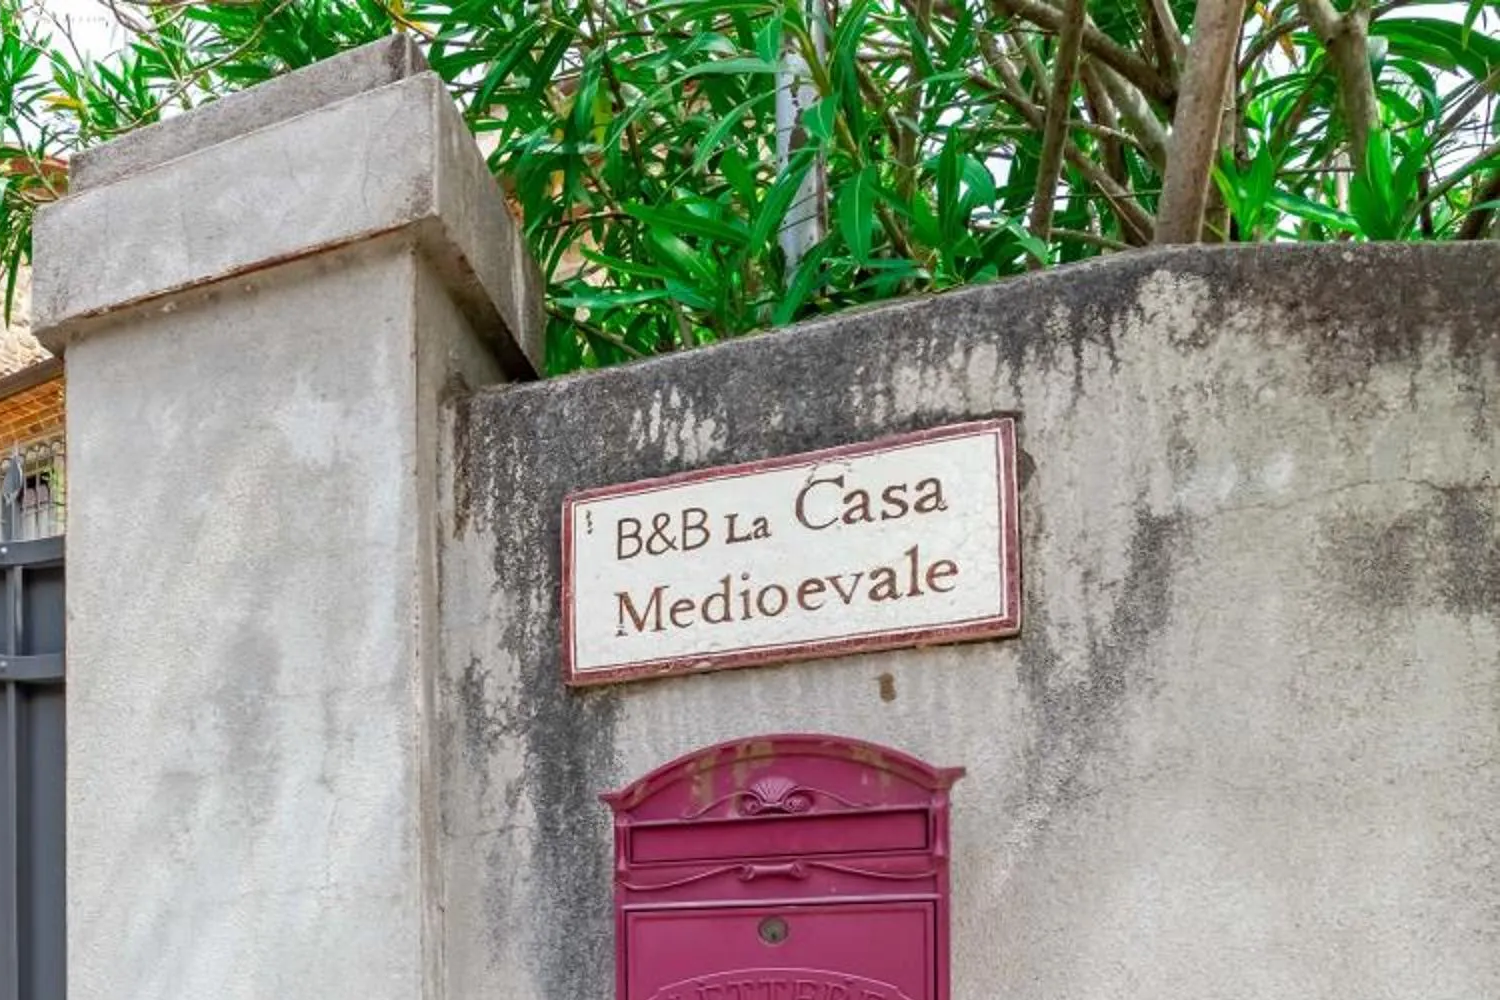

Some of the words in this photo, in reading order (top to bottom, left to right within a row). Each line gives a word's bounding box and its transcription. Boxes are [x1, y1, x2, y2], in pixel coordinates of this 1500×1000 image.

[616, 507, 711, 560] B&B
[724, 513, 772, 544] La
[795, 475, 948, 530] Casa
[615, 544, 959, 637] Medioevale
